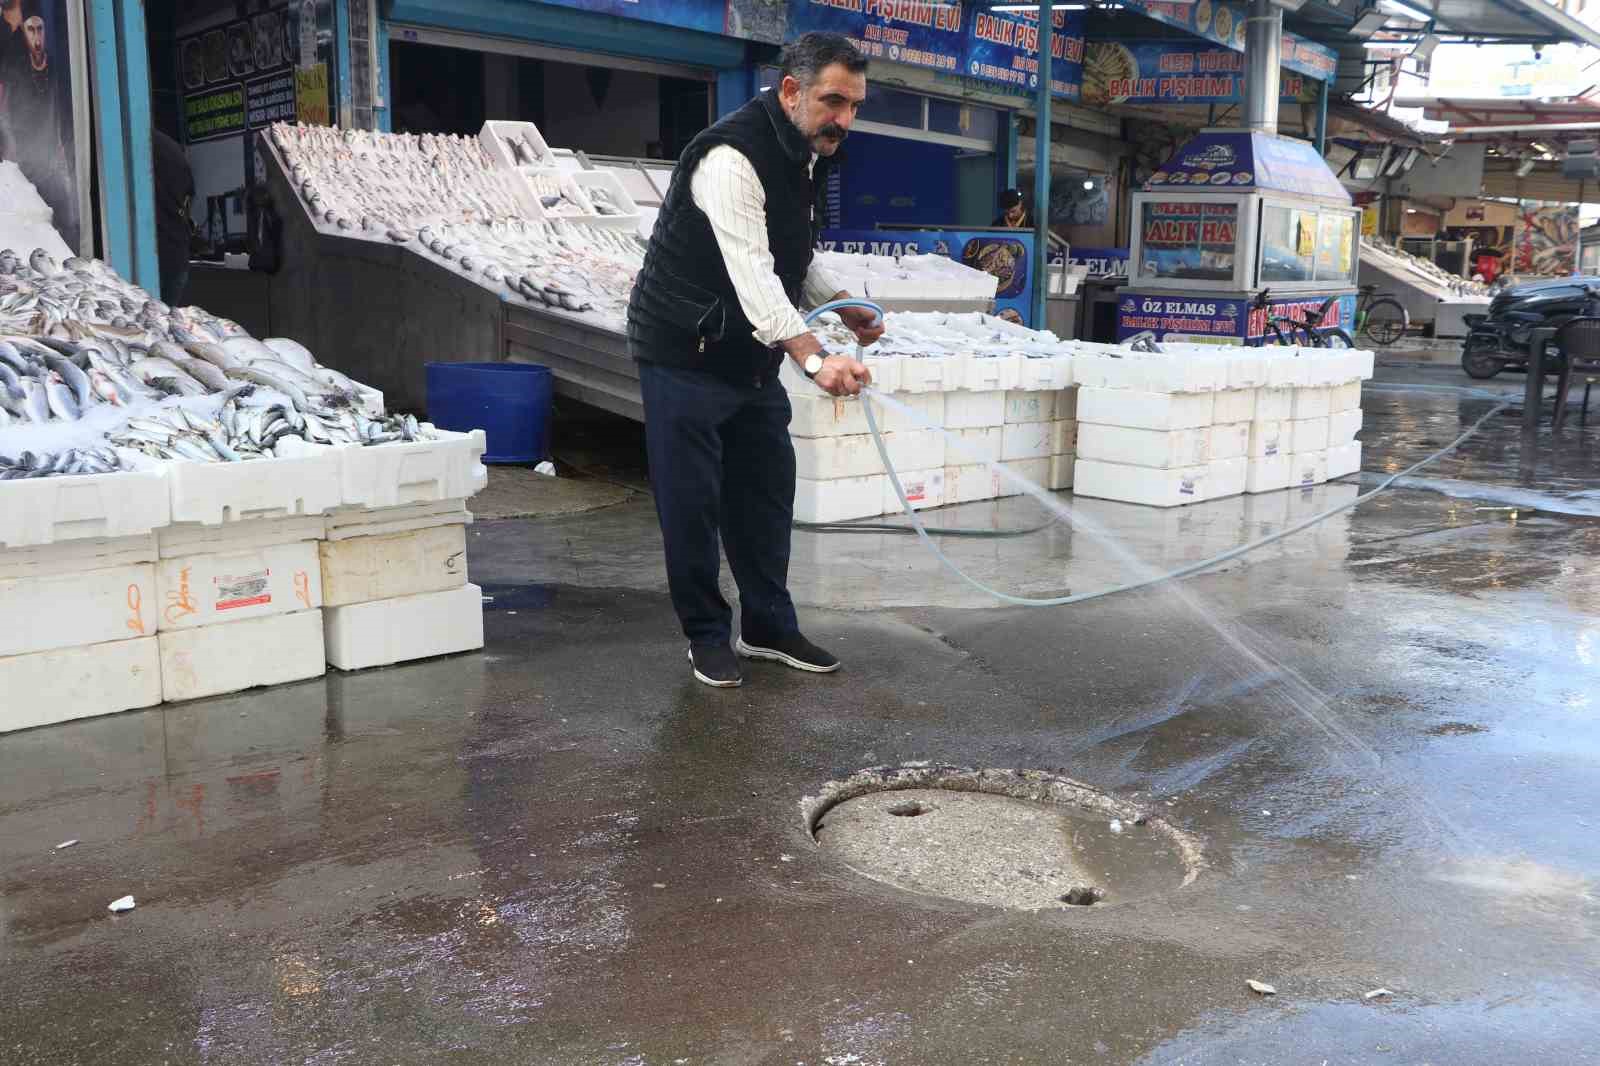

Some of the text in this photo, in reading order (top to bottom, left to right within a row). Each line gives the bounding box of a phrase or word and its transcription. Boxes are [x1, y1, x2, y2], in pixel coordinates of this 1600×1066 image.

[975, 12, 1014, 46] BALIK
[1014, 21, 1065, 58] PİŞM
[1159, 53, 1193, 72] HER
[1109, 78, 1156, 97] BALIK
[842, 241, 918, 257] ELMAS
[1142, 297, 1216, 316] ÖZ ELMAS
